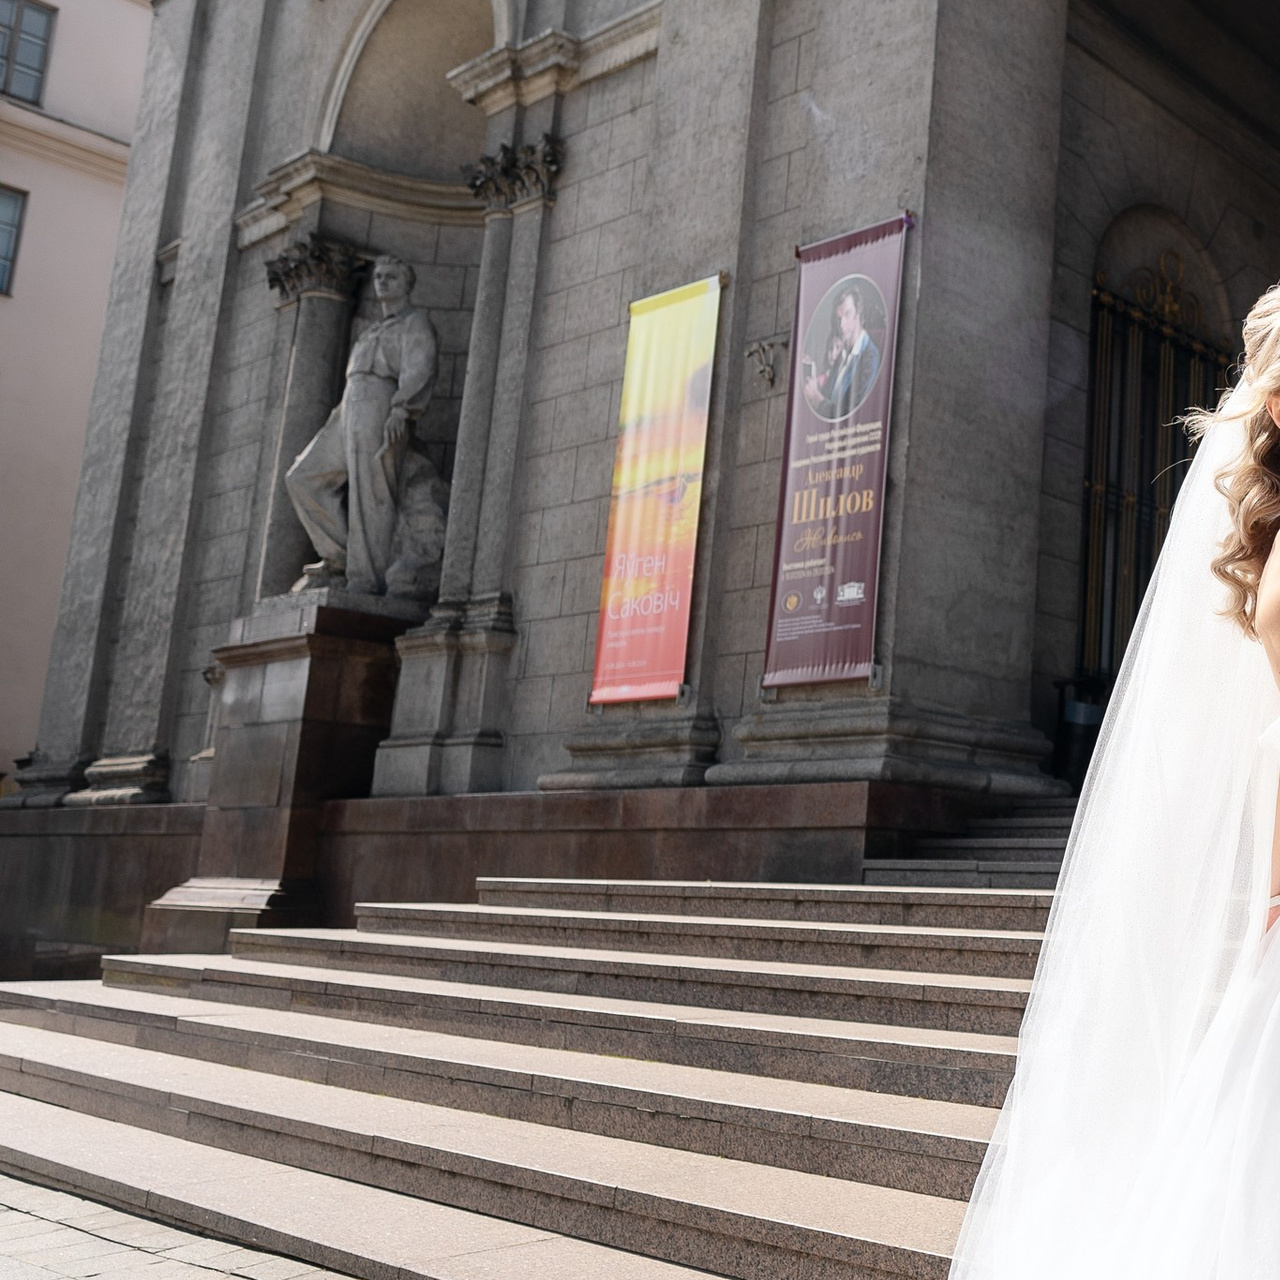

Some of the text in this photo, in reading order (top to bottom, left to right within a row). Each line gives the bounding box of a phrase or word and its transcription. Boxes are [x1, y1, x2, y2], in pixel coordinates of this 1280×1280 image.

[805, 463, 864, 485] Александр
[791, 488, 874, 525] Шилов
[614, 552, 666, 587] Яўген
[607, 586, 680, 620] Саковіч
